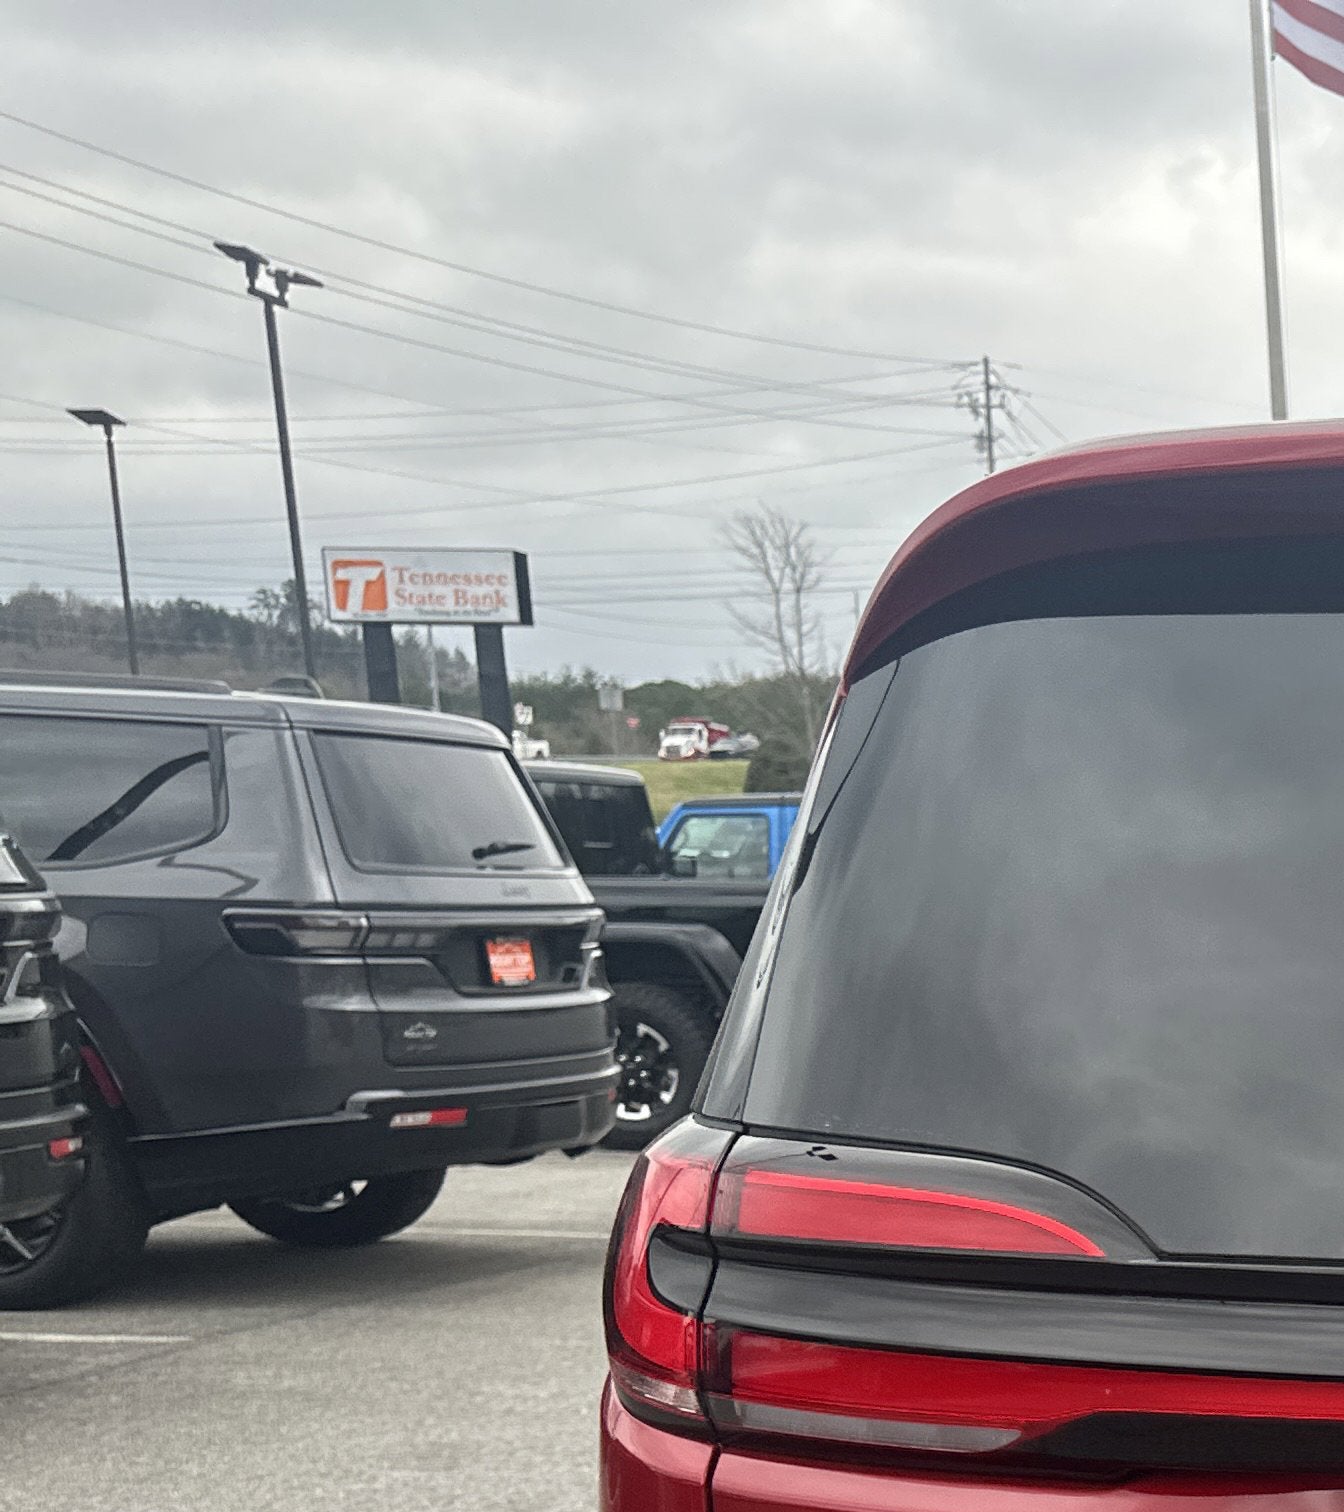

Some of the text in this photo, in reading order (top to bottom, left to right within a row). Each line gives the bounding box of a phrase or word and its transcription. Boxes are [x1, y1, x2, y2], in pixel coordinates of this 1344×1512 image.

[392, 566, 508, 587] Tennessee
[394, 588, 508, 608] State Bank
